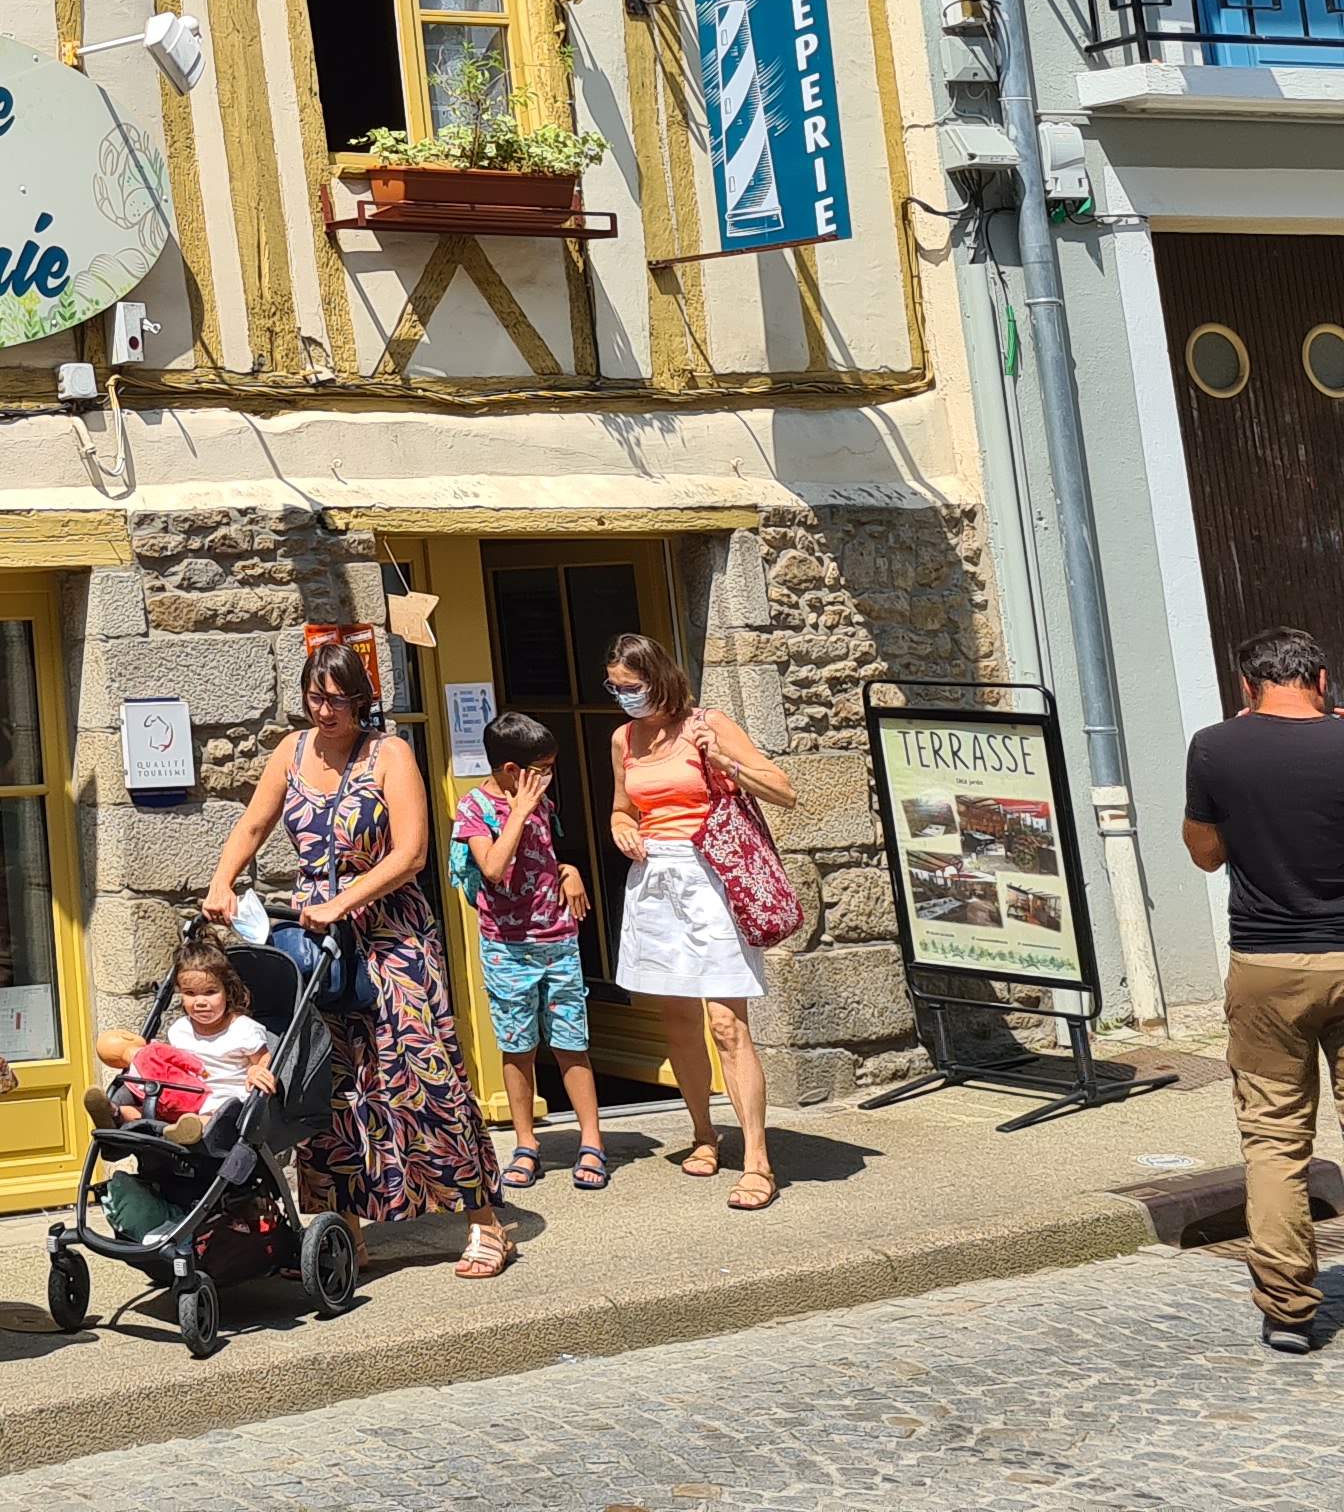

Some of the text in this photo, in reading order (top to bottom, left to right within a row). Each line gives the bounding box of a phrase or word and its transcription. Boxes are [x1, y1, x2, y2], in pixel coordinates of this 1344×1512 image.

[897, 730, 1036, 776] TERRASSE
[136, 758, 185, 769] QUALITÉ
[137, 768, 186, 778] TOURISME
